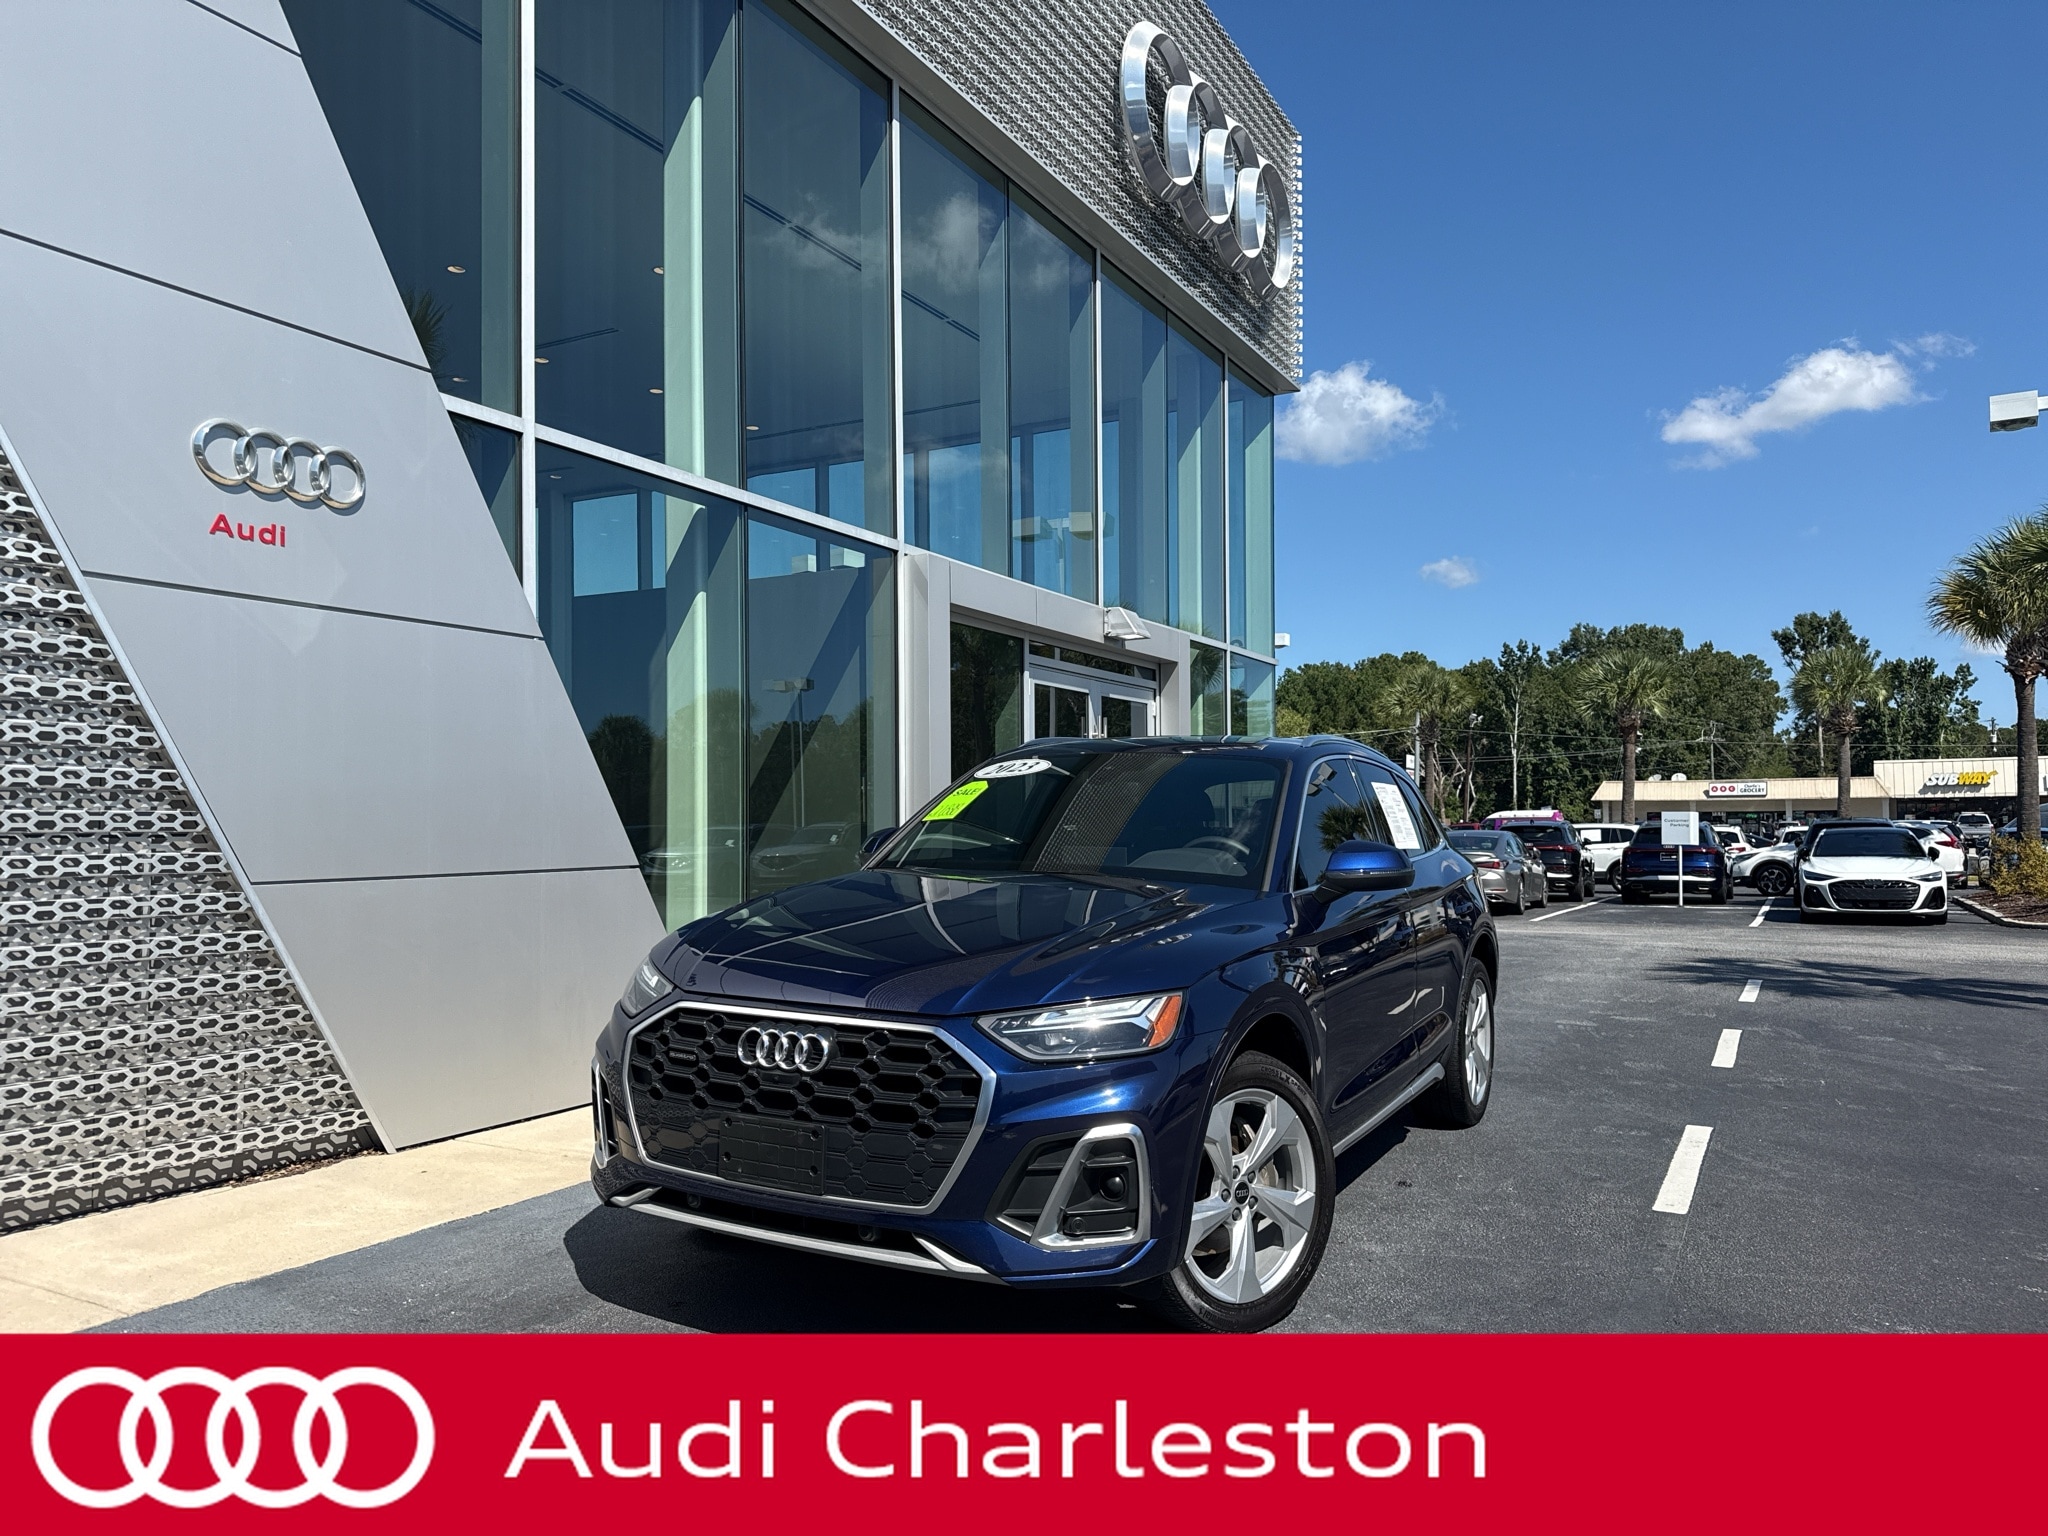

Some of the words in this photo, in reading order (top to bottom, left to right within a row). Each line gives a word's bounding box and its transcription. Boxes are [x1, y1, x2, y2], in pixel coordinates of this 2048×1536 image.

[209, 513, 286, 548] Audi
[982, 761, 1041, 776] 2023
[1925, 770, 1998, 786] SUBWAY
